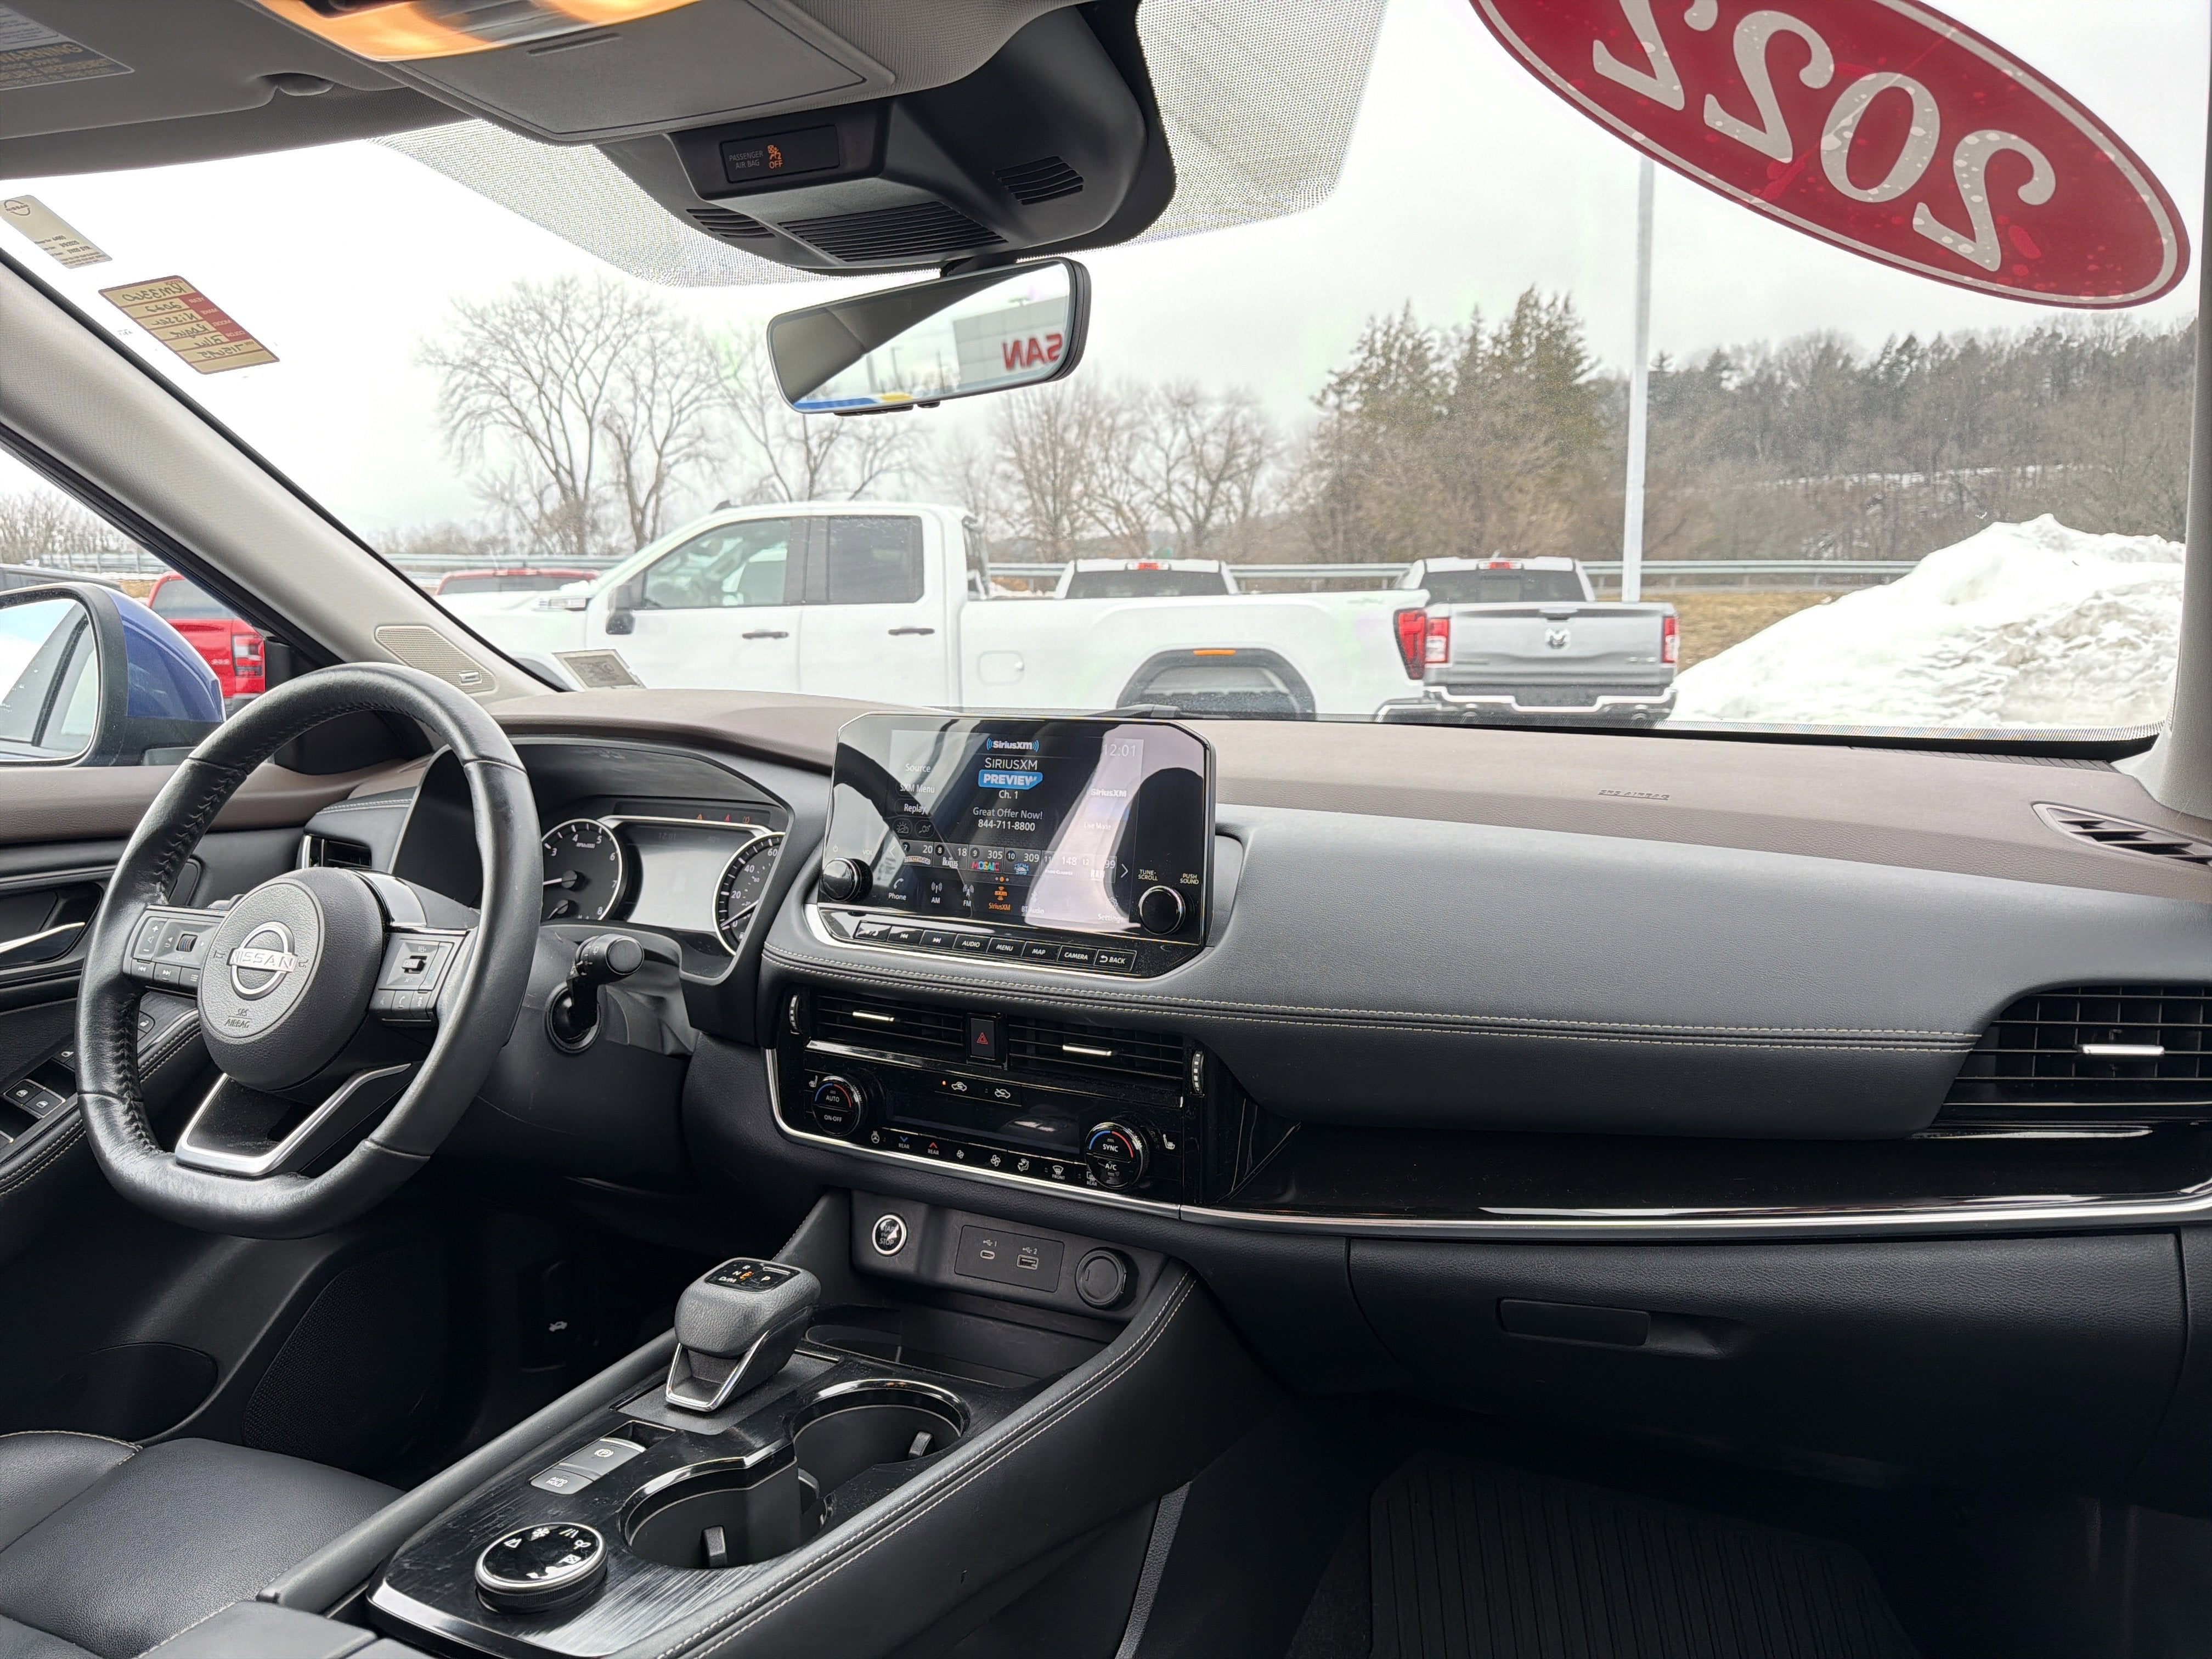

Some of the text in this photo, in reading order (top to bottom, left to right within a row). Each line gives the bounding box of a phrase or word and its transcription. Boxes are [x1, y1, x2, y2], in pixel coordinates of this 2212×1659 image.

[729, 150, 763, 161] PASSENGER
[735, 159, 760, 170] AIR BAG
[769, 160, 783, 169] OFF
[1103, 744, 1136, 757] 12:01
[905, 763, 931, 773] Source
[984, 774, 1037, 786] PREVIEW
[900, 783, 935, 793] SXM Menu
[998, 790, 1018, 799] Ch. 1
[904, 803, 926, 815] Replay
[973, 806, 1042, 820] Great Offer Now!
[978, 819, 1035, 831] 844-711-8800
[572, 834, 578, 842] 4
[596, 835, 602, 844] 5
[550, 848, 557, 857] 3
[768, 848, 778, 857] 60
[922, 844, 933, 854] 20
[957, 847, 968, 857] 18
[610, 852, 616, 861] 6
[987, 850, 1003, 860] 305
[1007, 852, 1015, 860] 10
[1023, 853, 1040, 863] 309
[1062, 856, 1078, 866] 148
[744, 864, 755, 873] 40
[971, 861, 1000, 871] MOSAIC
[612, 880, 617, 888] 7
[731, 890, 742, 899] 20
[888, 892, 907, 901] Phone
[597, 906, 603, 915] 8
[988, 902, 1011, 911] SiriusXM
[962, 940, 980, 948] AUDIO
[996, 944, 1014, 952] MENU
[230, 950, 294, 969] NISSAN
[1064, 952, 1088, 960] CAMERA
[1109, 956, 1126, 964] BACK
[826, 1094, 840, 1103] AUTO
[1103, 1143, 1119, 1152] SYNC
[879, 1238, 894, 1246] STOP
